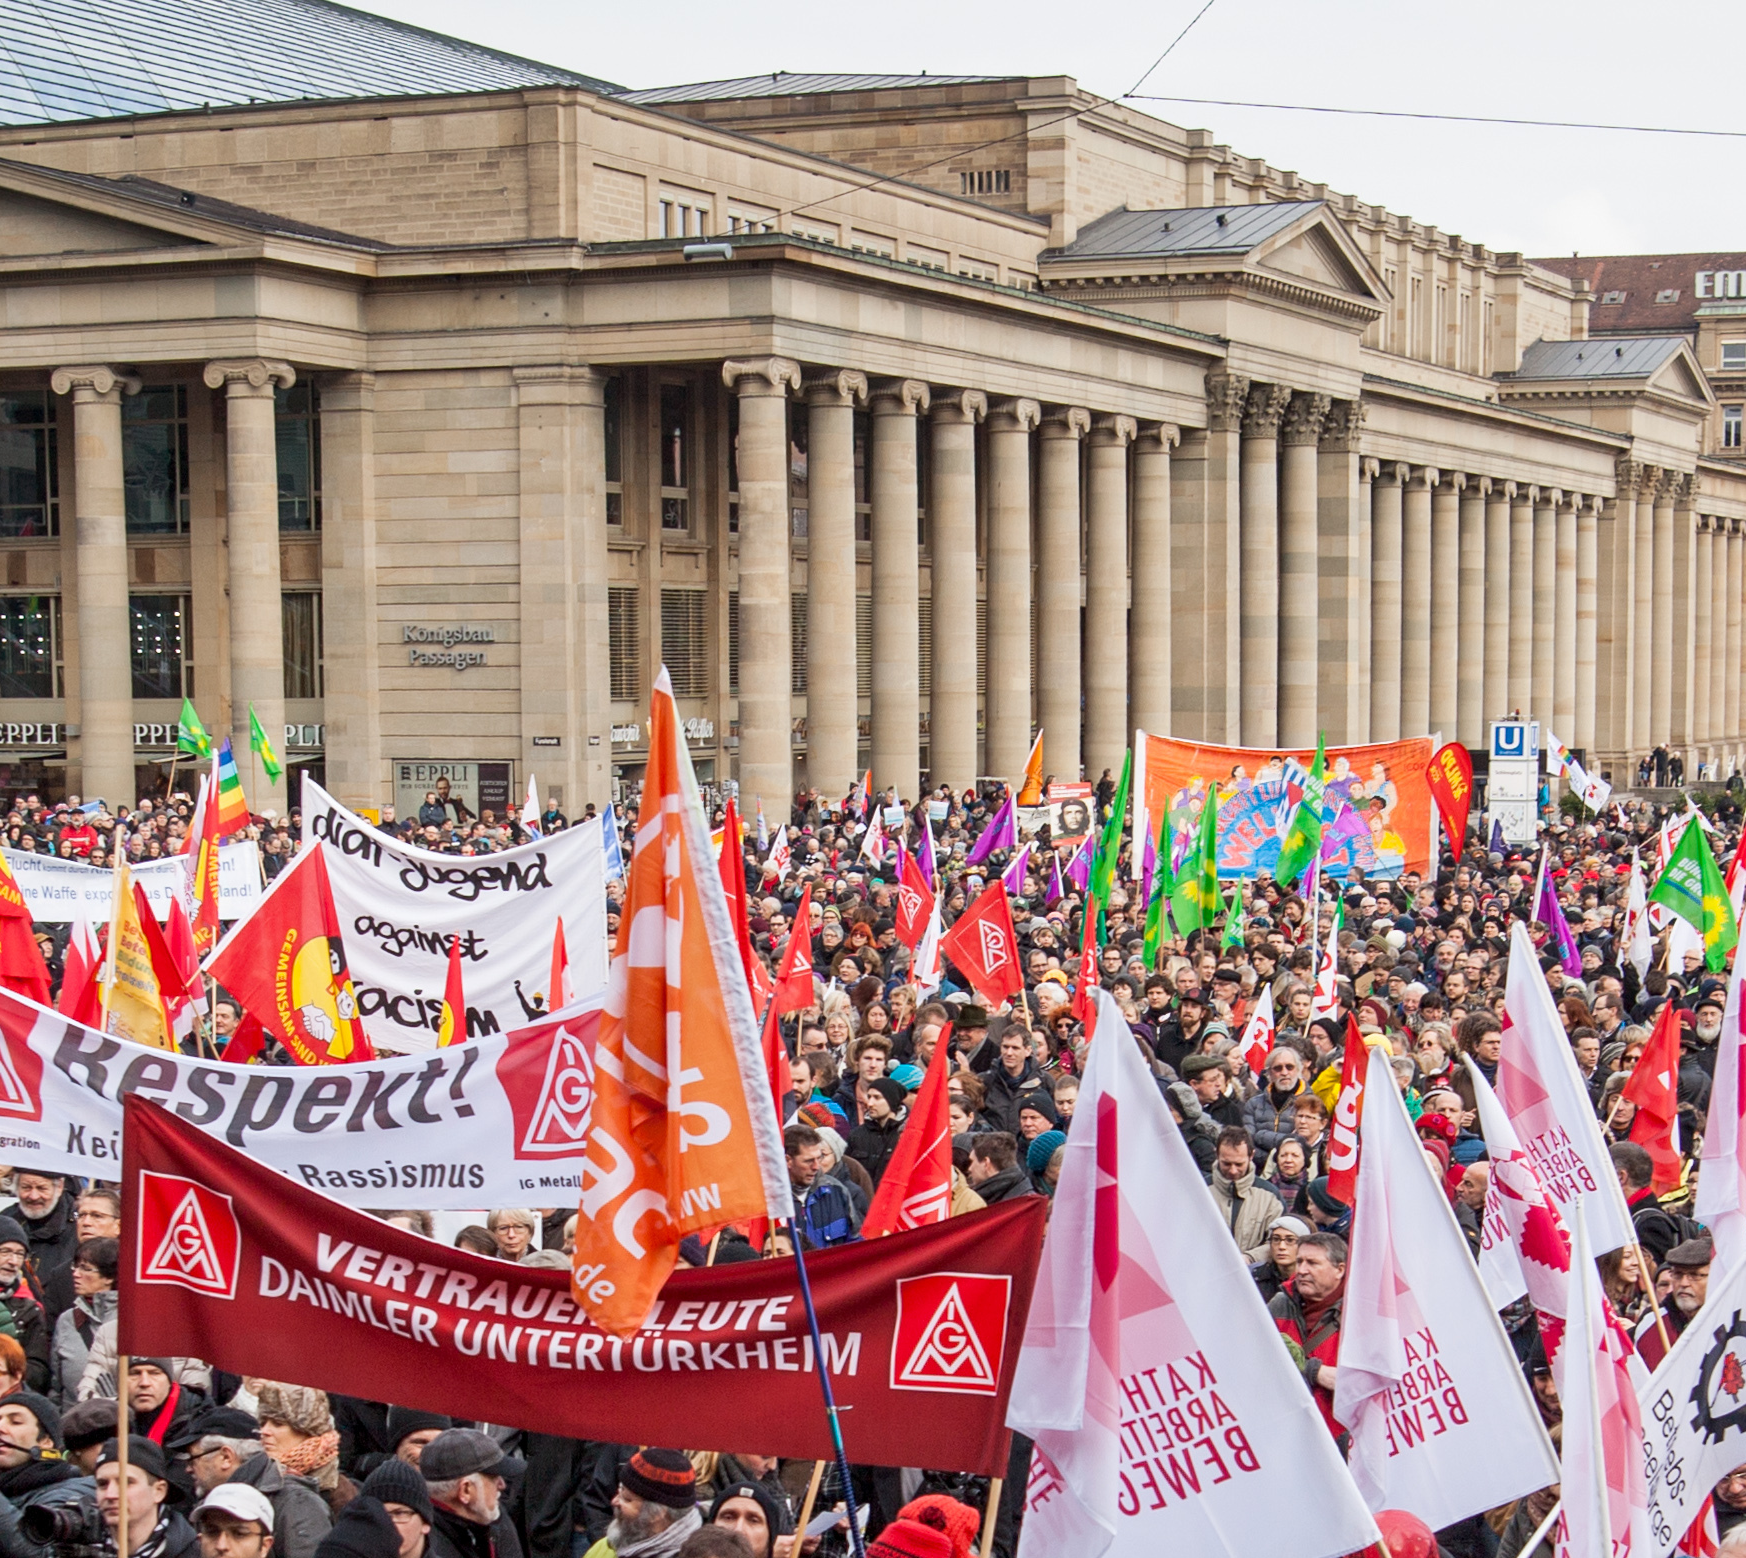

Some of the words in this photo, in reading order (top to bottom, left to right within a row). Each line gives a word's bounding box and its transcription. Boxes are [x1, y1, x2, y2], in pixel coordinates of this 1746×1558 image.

[402, 624, 495, 648] Königsbau
[408, 649, 488, 671] Passagen
[415, 765, 469, 782] EPPLI
[41, 885, 78, 899] Waffe
[354, 915, 489, 962] against
[275, 928, 298, 1037] GEMEINSAM
[53, 1023, 480, 1148] Respekt!
[66, 1122, 121, 1163] Kei
[304, 1159, 485, 1191] Rassismus
[519, 1178, 536, 1191] IG
[315, 1232, 795, 1334] VERTRAUELEUTE
[258, 1255, 440, 1349] DAIMLER
[454, 1318, 862, 1376] UNTERTÜRKHEIM
